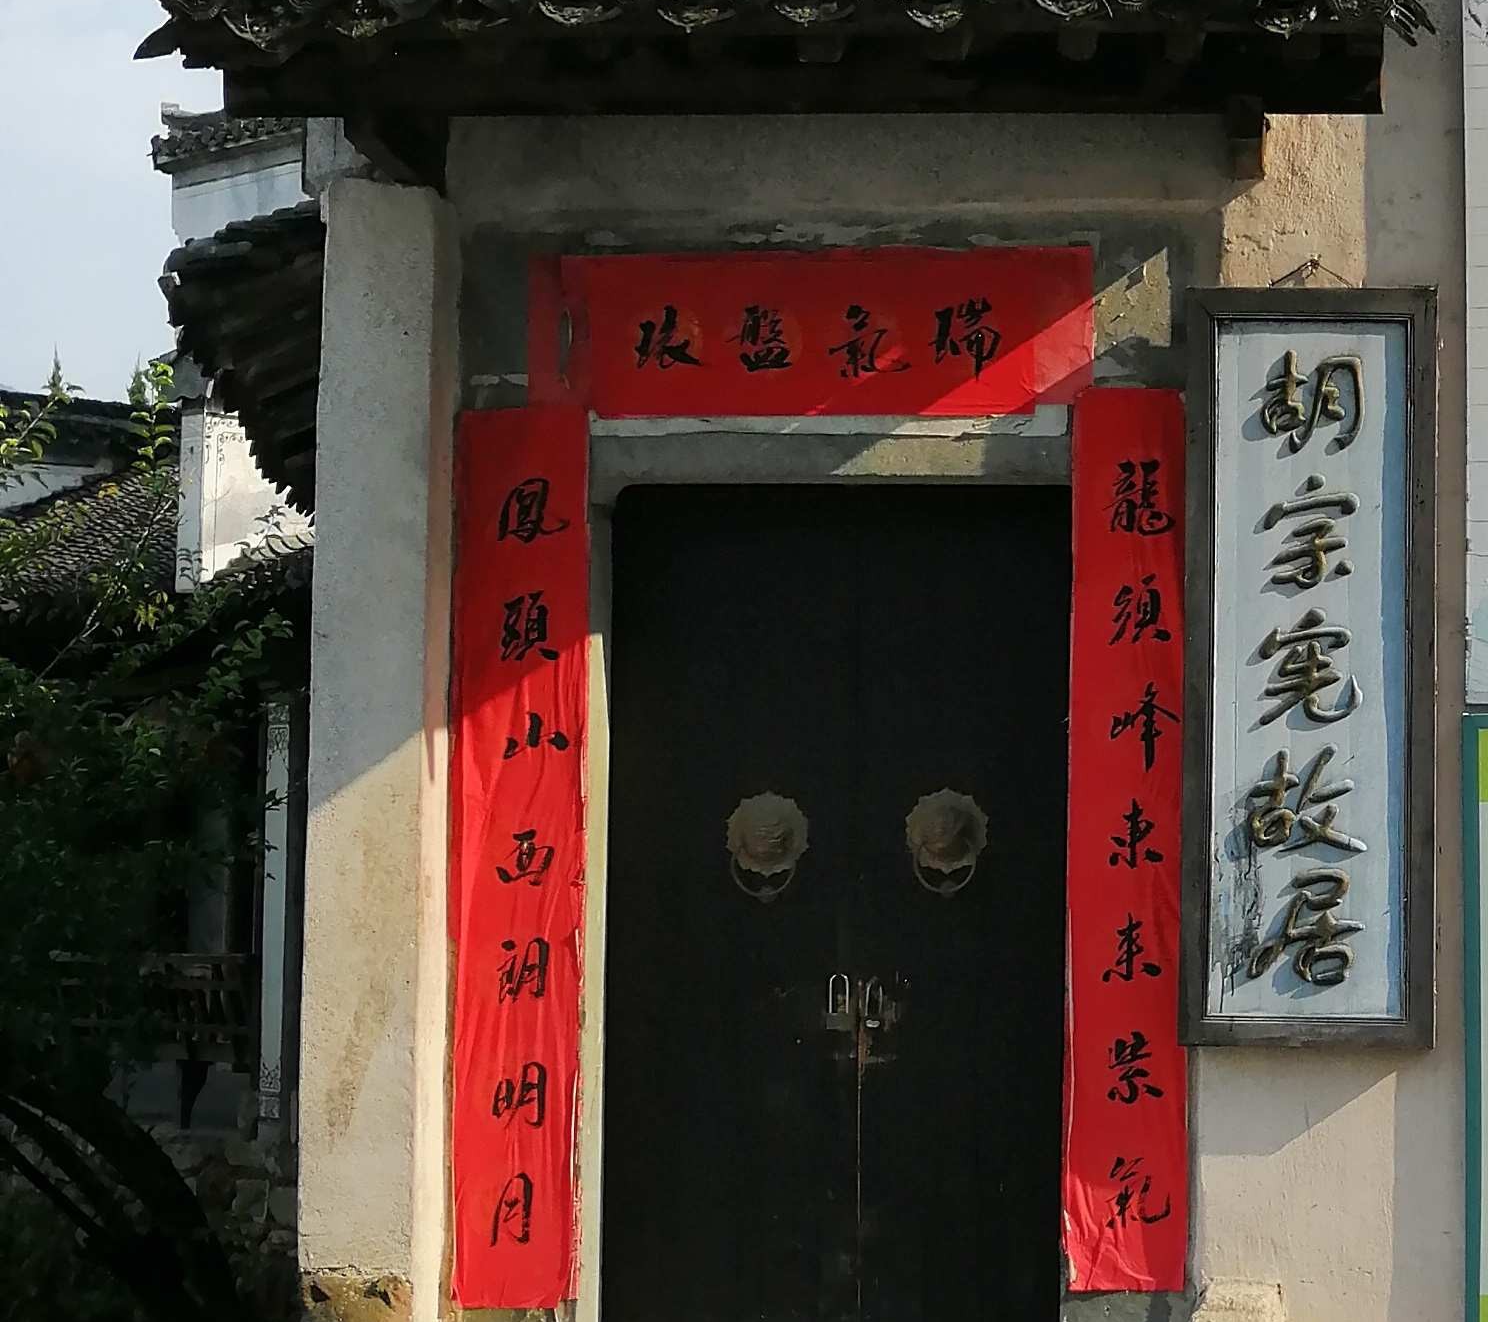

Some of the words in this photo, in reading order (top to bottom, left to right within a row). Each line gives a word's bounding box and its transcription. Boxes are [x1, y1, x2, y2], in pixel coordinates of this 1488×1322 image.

[1247, 348, 1367, 986] 胡宗宪故居
